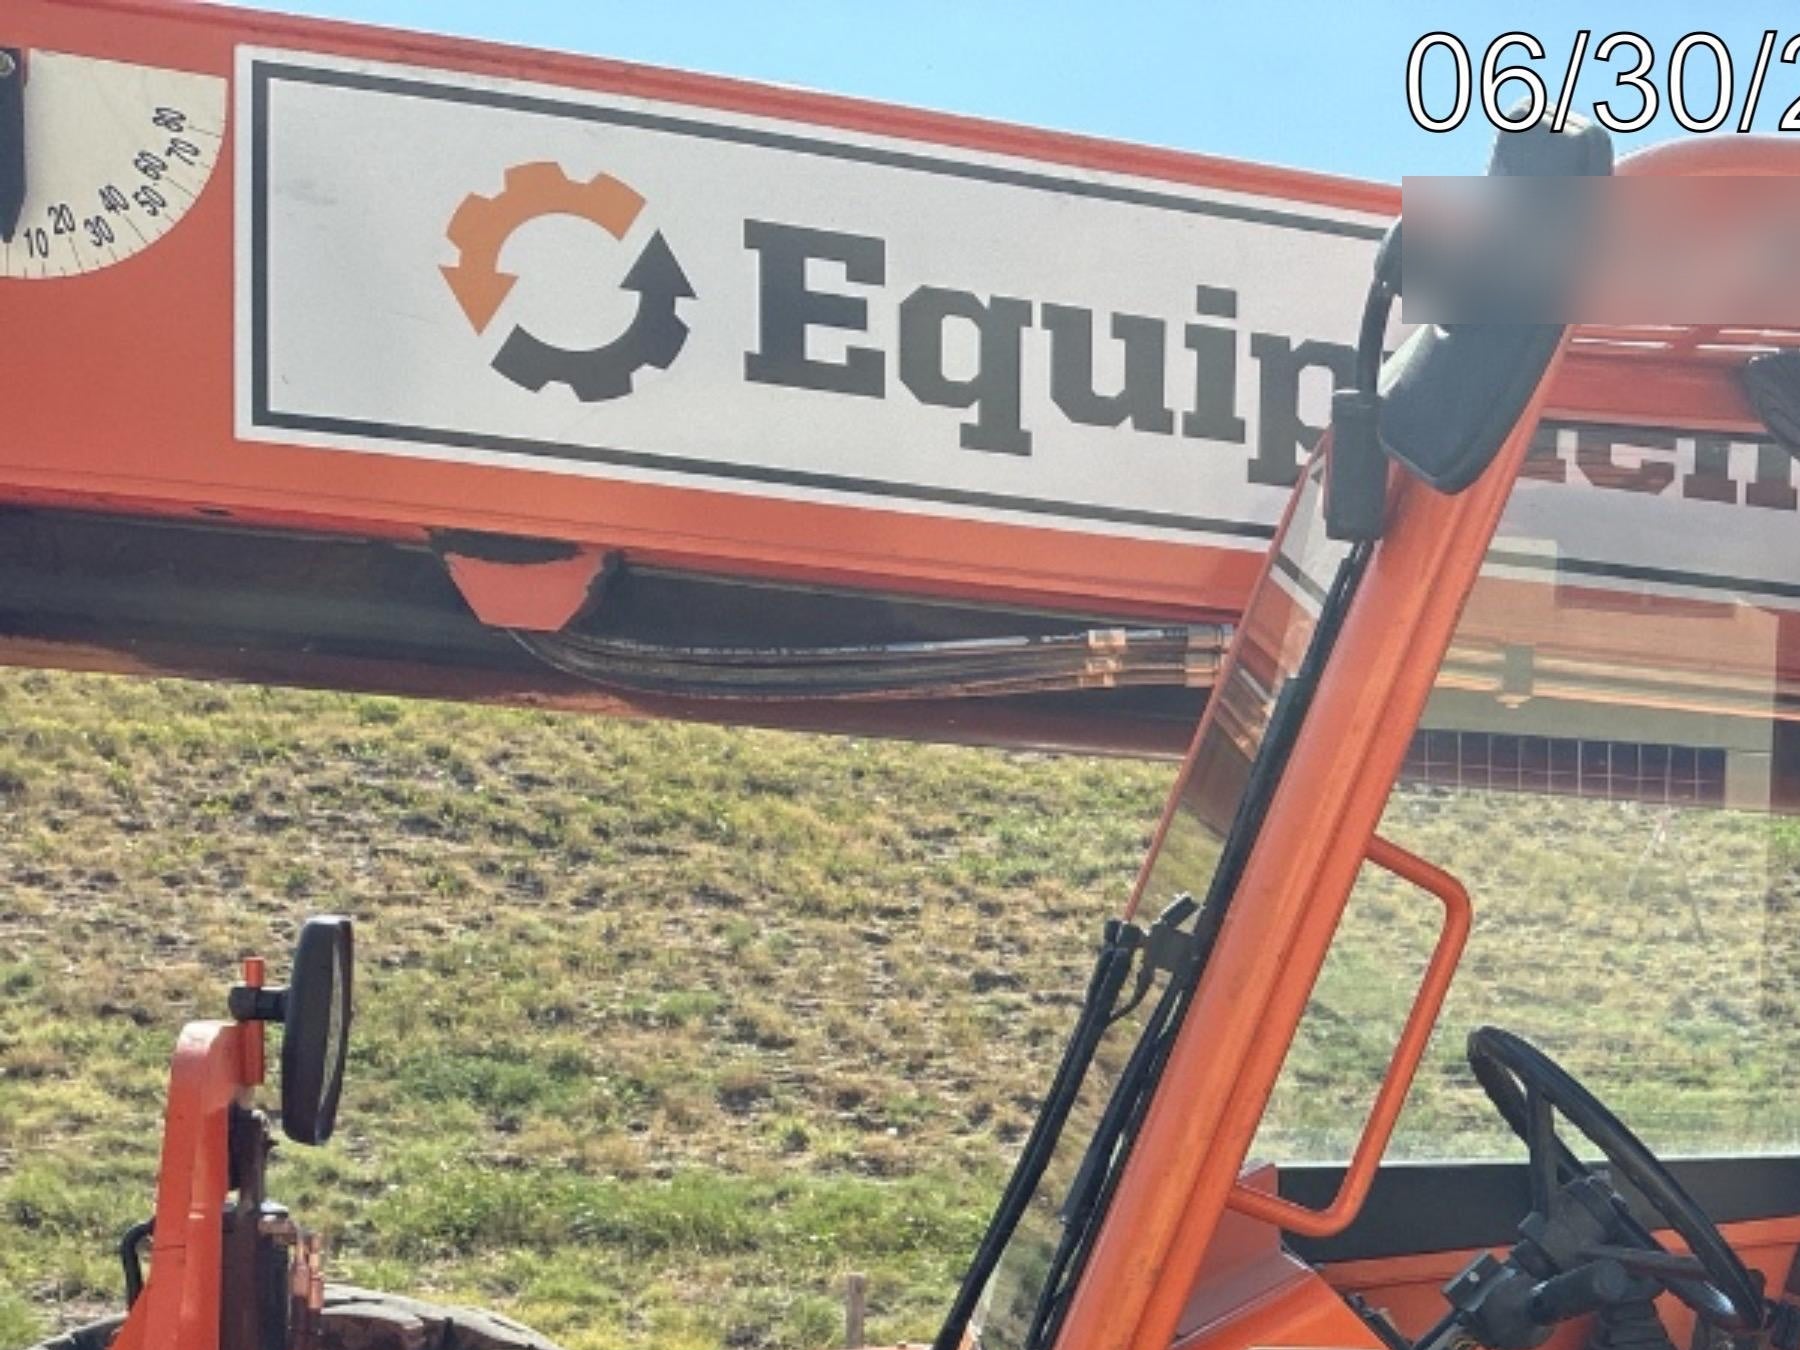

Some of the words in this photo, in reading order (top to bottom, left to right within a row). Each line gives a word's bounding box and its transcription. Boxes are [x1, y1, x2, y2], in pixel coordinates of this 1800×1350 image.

[165, 137, 200, 166] 70
[98, 184, 130, 215] 40
[132, 185, 167, 216] 50
[47, 203, 75, 235] 20
[84, 215, 115, 247] 30
[24, 227, 48, 258] 10
